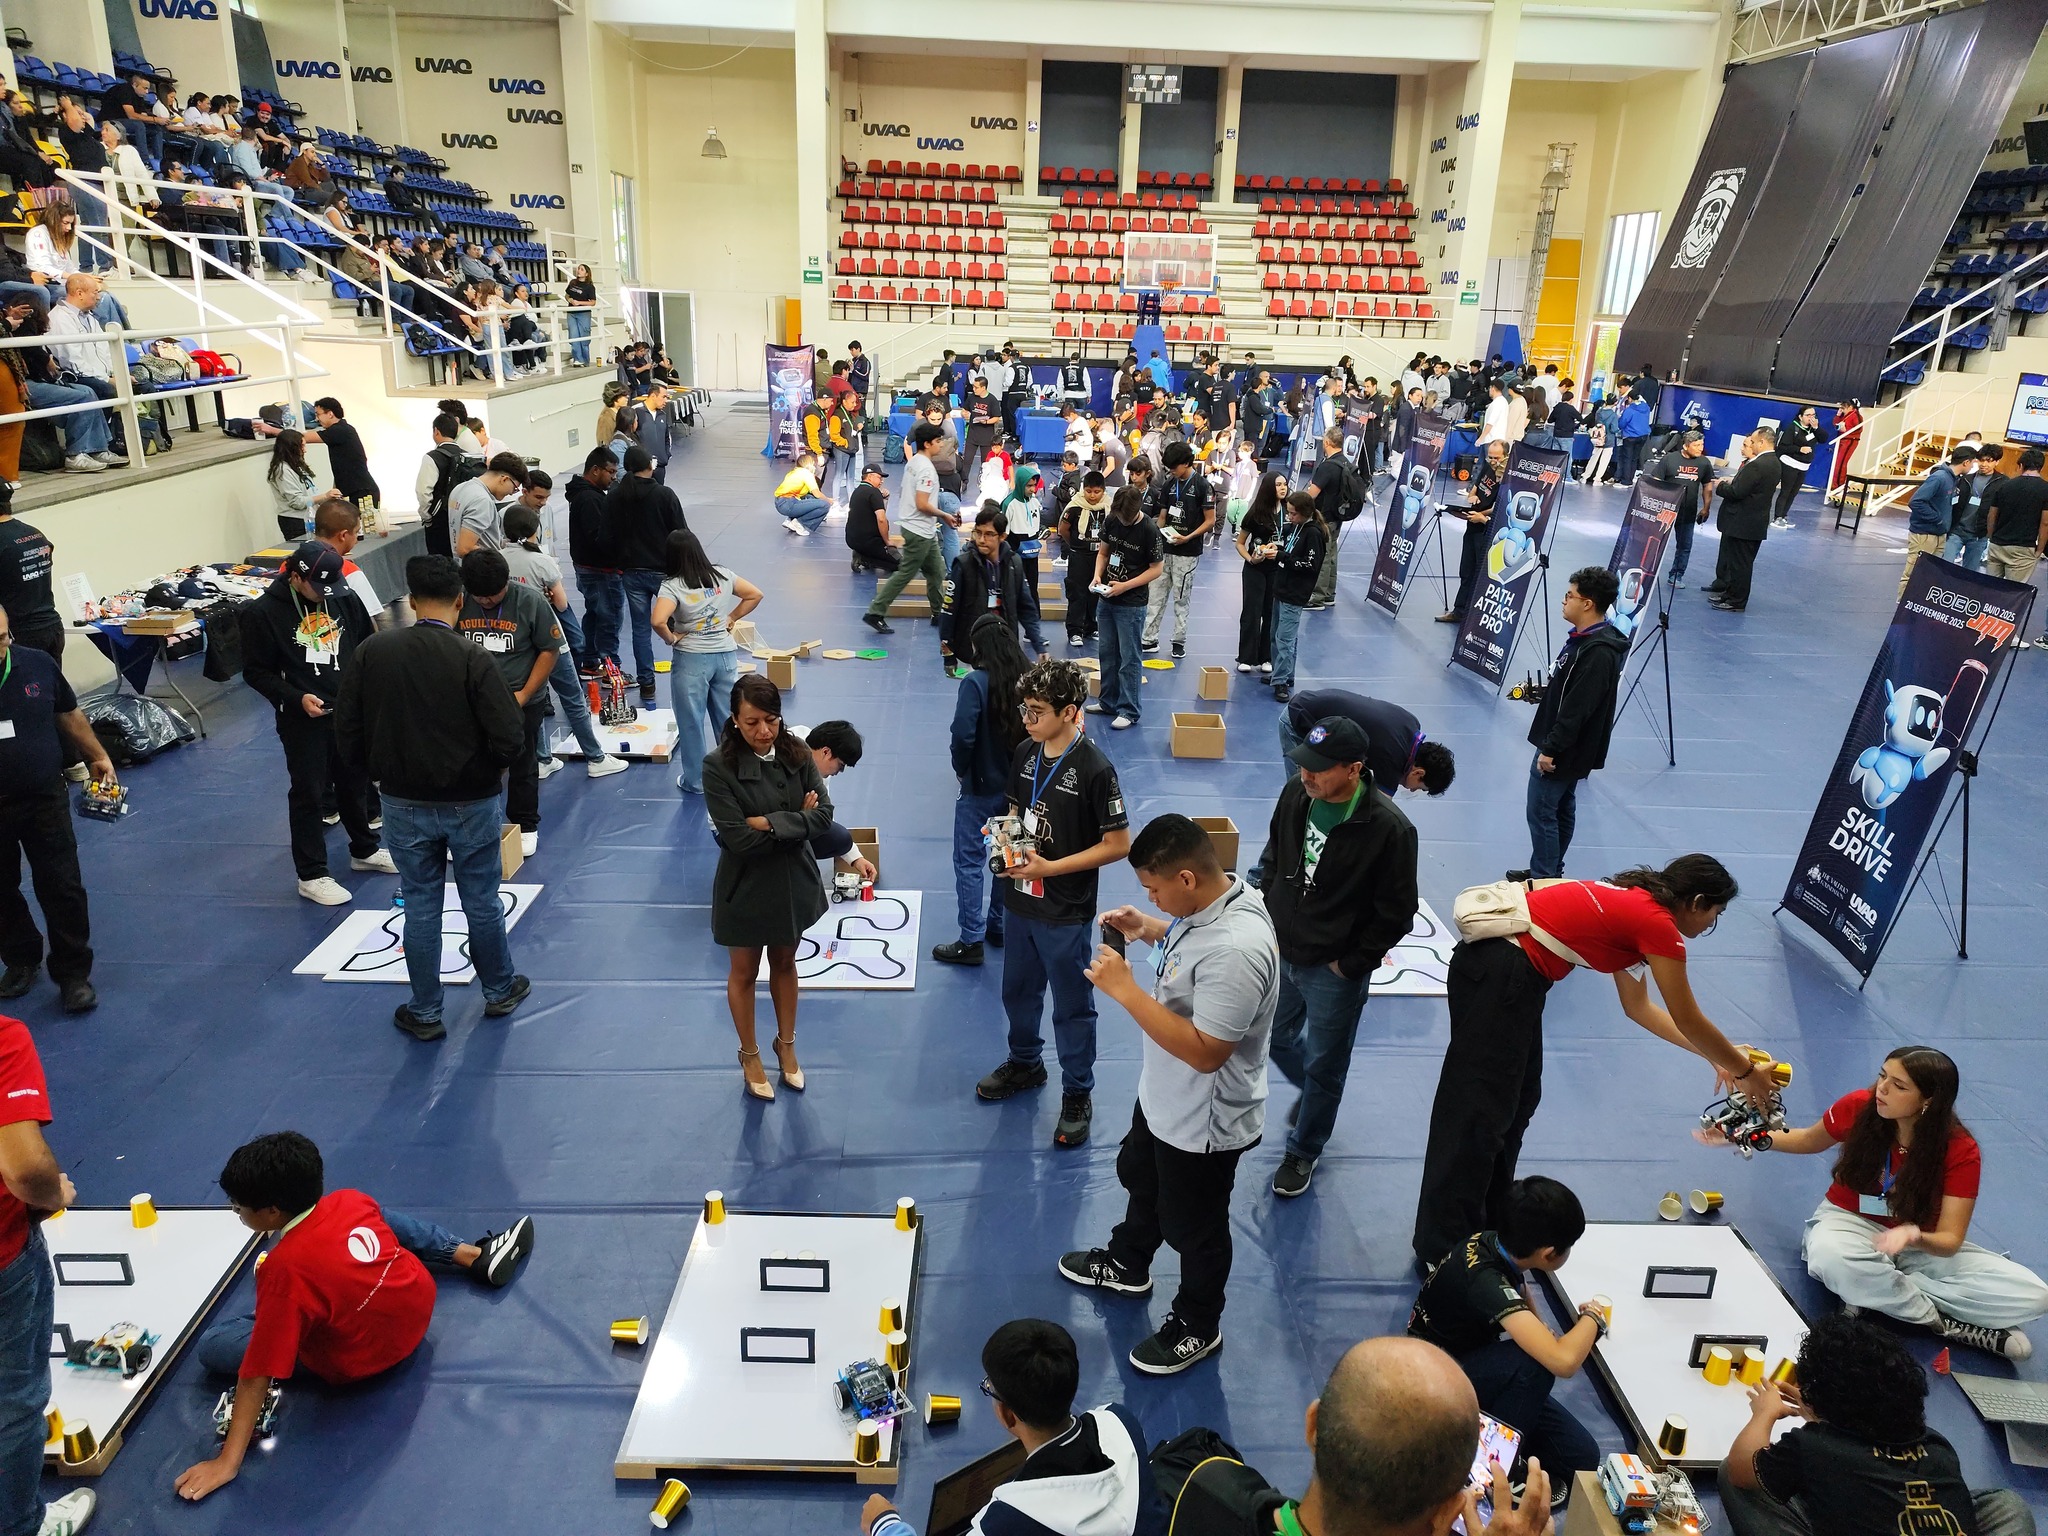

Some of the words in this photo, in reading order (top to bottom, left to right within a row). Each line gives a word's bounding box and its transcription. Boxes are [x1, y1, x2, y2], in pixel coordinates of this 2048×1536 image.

[140, 0, 219, 20] UVAQ
[275, 60, 341, 79] UVAQ
[350, 66, 393, 83] VAQ
[415, 57, 473, 75] UVAQ
[489, 78, 546, 95] UVAQ
[507, 108, 564, 125] UVAQ
[971, 116, 1018, 130] UVAQ
[863, 123, 911, 137] UVAQ
[442, 133, 498, 150] UVAQ
[917, 137, 964, 151] UVAQ
[510, 194, 566, 209] UVAQ
[1677, 465, 1699, 474] JUEZ
[1484, 583, 1516, 607] PATH
[1925, 585, 1982, 617] ROBO
[1999, 608, 2017, 622] 2025
[1473, 596, 1518, 625] ATTACK
[1904, 600, 1913, 610] 20
[1911, 603, 1950, 624] SEPTIEMBRE
[1948, 616, 1966, 630] 2025
[1479, 613, 1503, 634] PRO
[1966, 612, 2016, 653] JAM
[1841, 806, 1896, 858] SKILL
[1828, 826, 1893, 883] DRIVE
[1849, 892, 1878, 926] UVAQ
